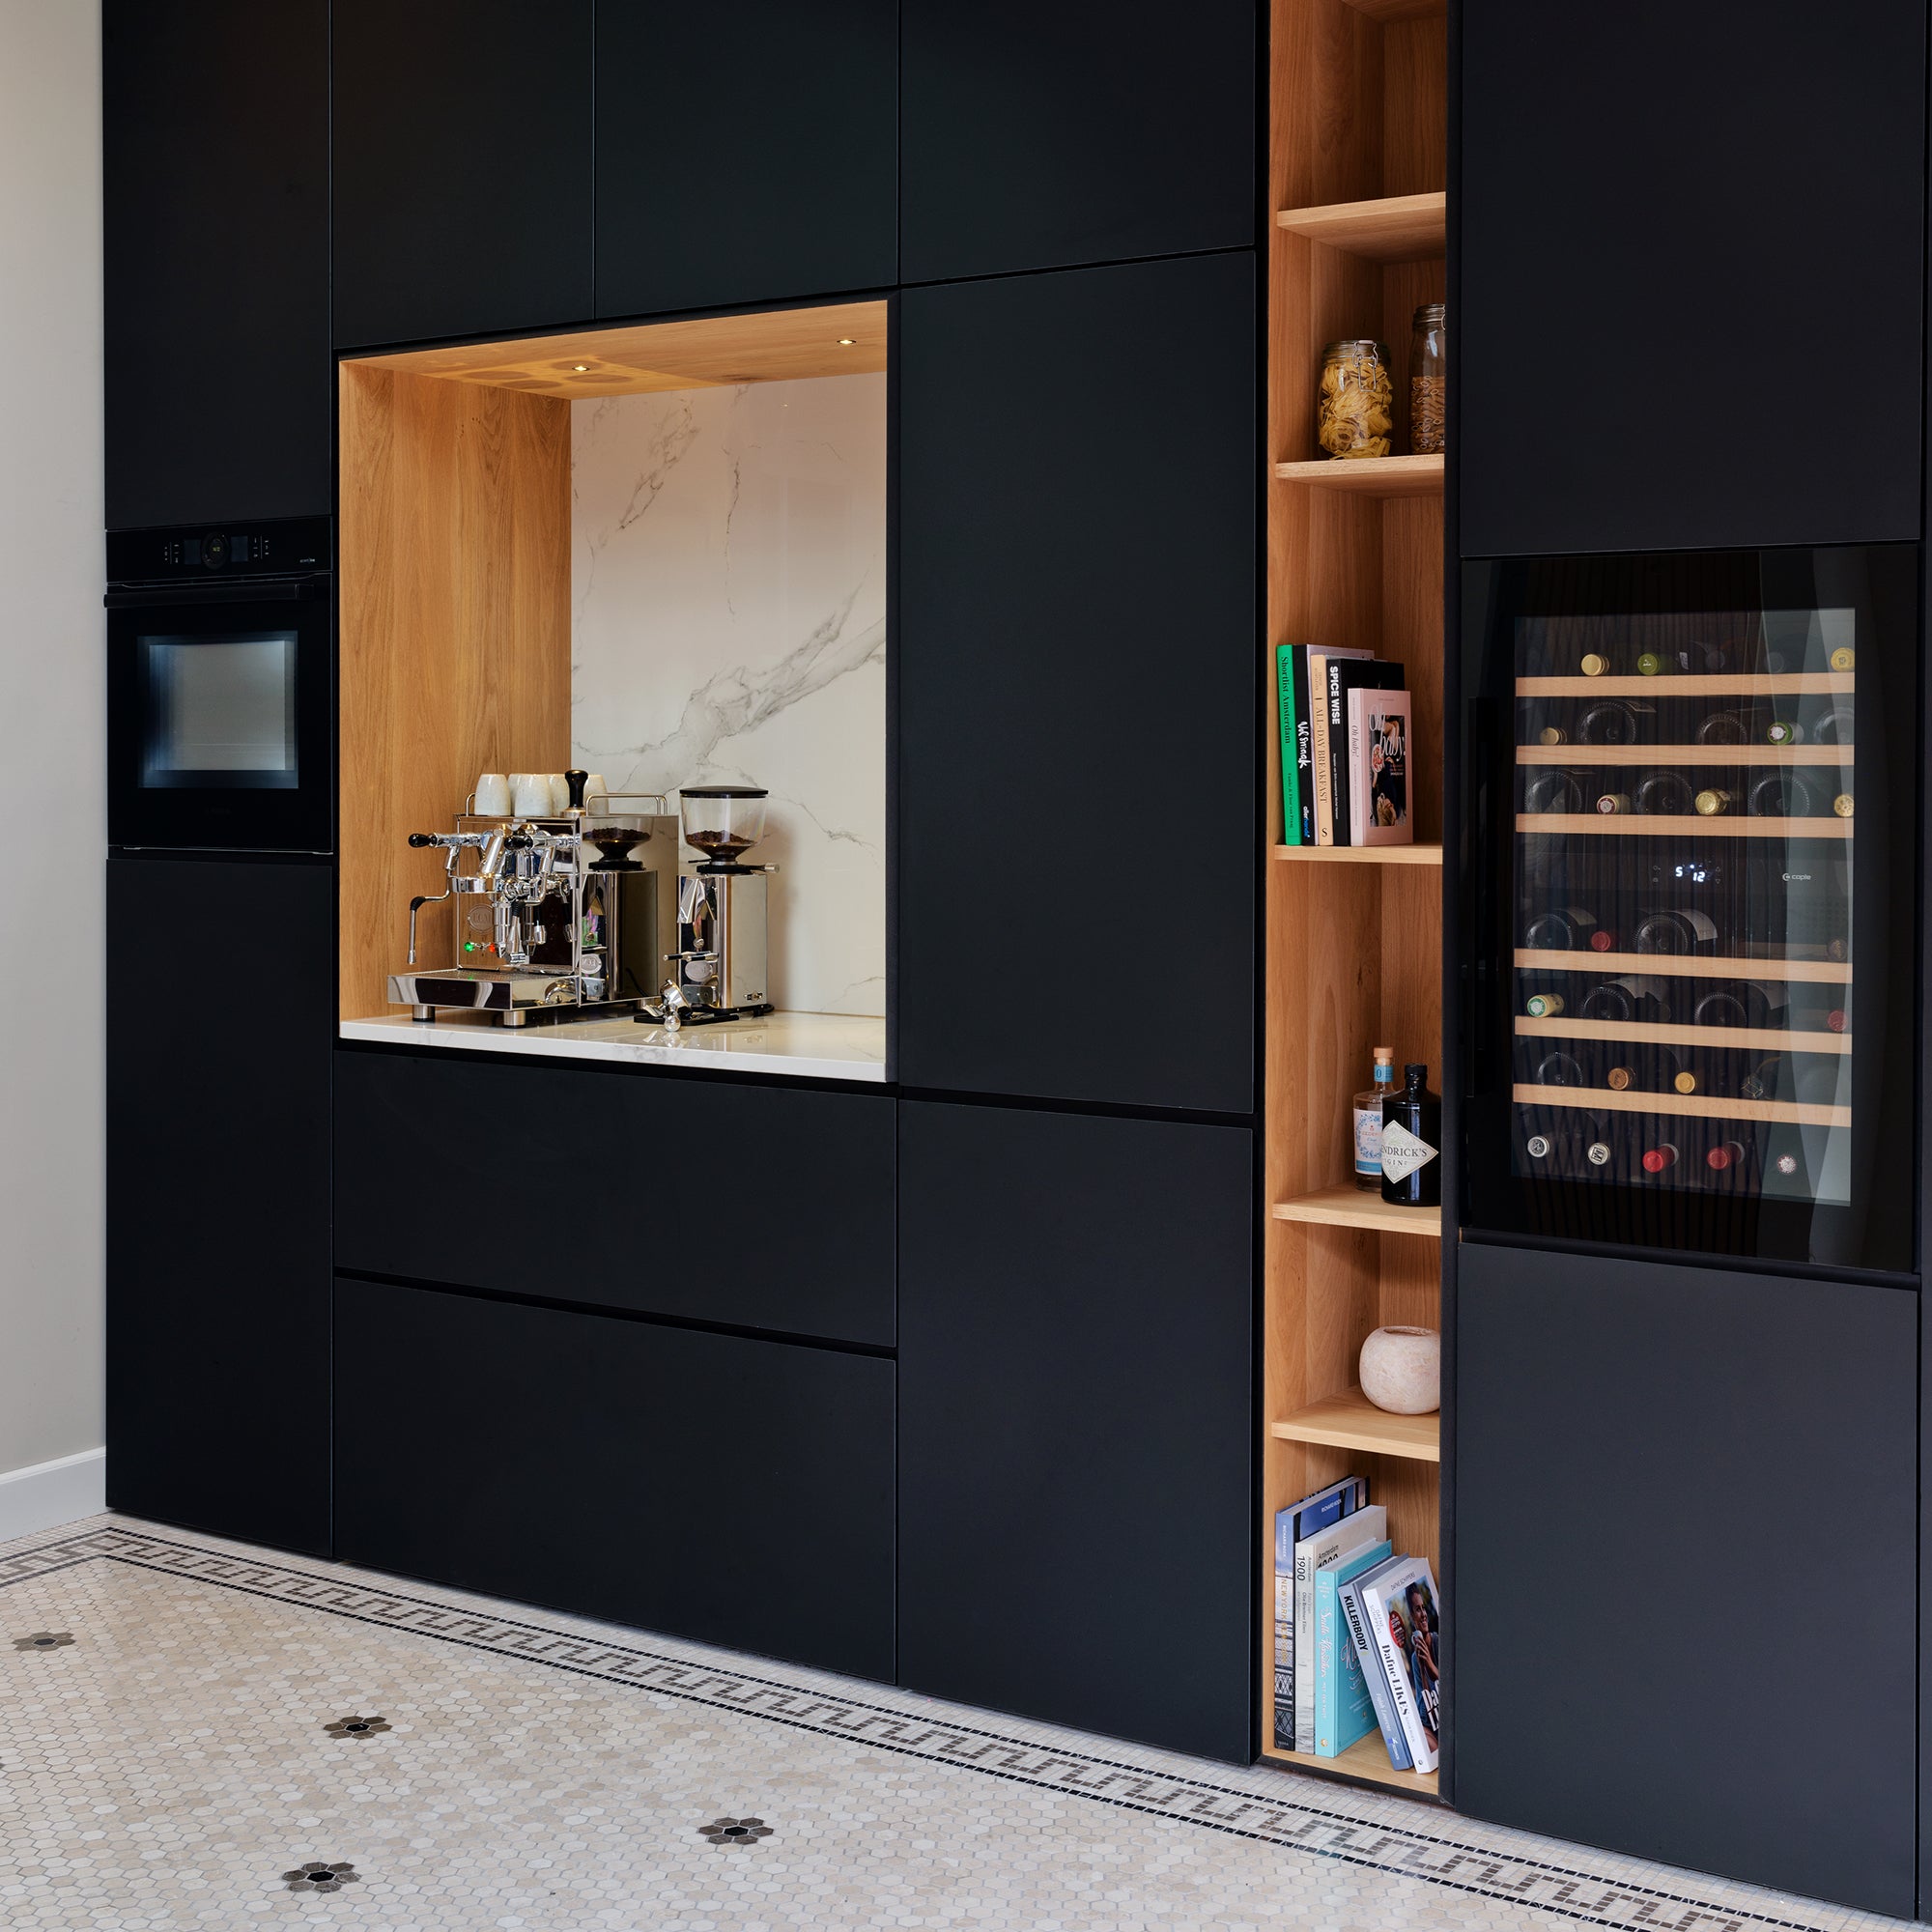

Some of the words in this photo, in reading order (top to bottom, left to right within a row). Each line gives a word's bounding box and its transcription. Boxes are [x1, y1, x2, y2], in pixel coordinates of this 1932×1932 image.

[1280, 656, 1290, 693] Shortlist
[1329, 666, 1340, 696] SPICE
[1282, 695, 1291, 744] Amsterdam
[1331, 697, 1341, 724] WISE
[1316, 707, 1325, 747] ALL-DAY
[1351, 724, 1359, 736] Oh
[1297, 736, 1311, 769] smaak
[1350, 738, 1360, 757] baby!
[1318, 748, 1328, 804] BREAKFAST
[1675, 867, 1683, 877] 5
[1692, 871, 1706, 882] 12
[1387, 1158, 1404, 1167] GIN
[1296, 1555, 1305, 1581] 1900
[1344, 1595, 1368, 1651] KILLERBODY
[1381, 1644, 1397, 1677] Dafne
[1391, 1679, 1408, 1716] LIKES
